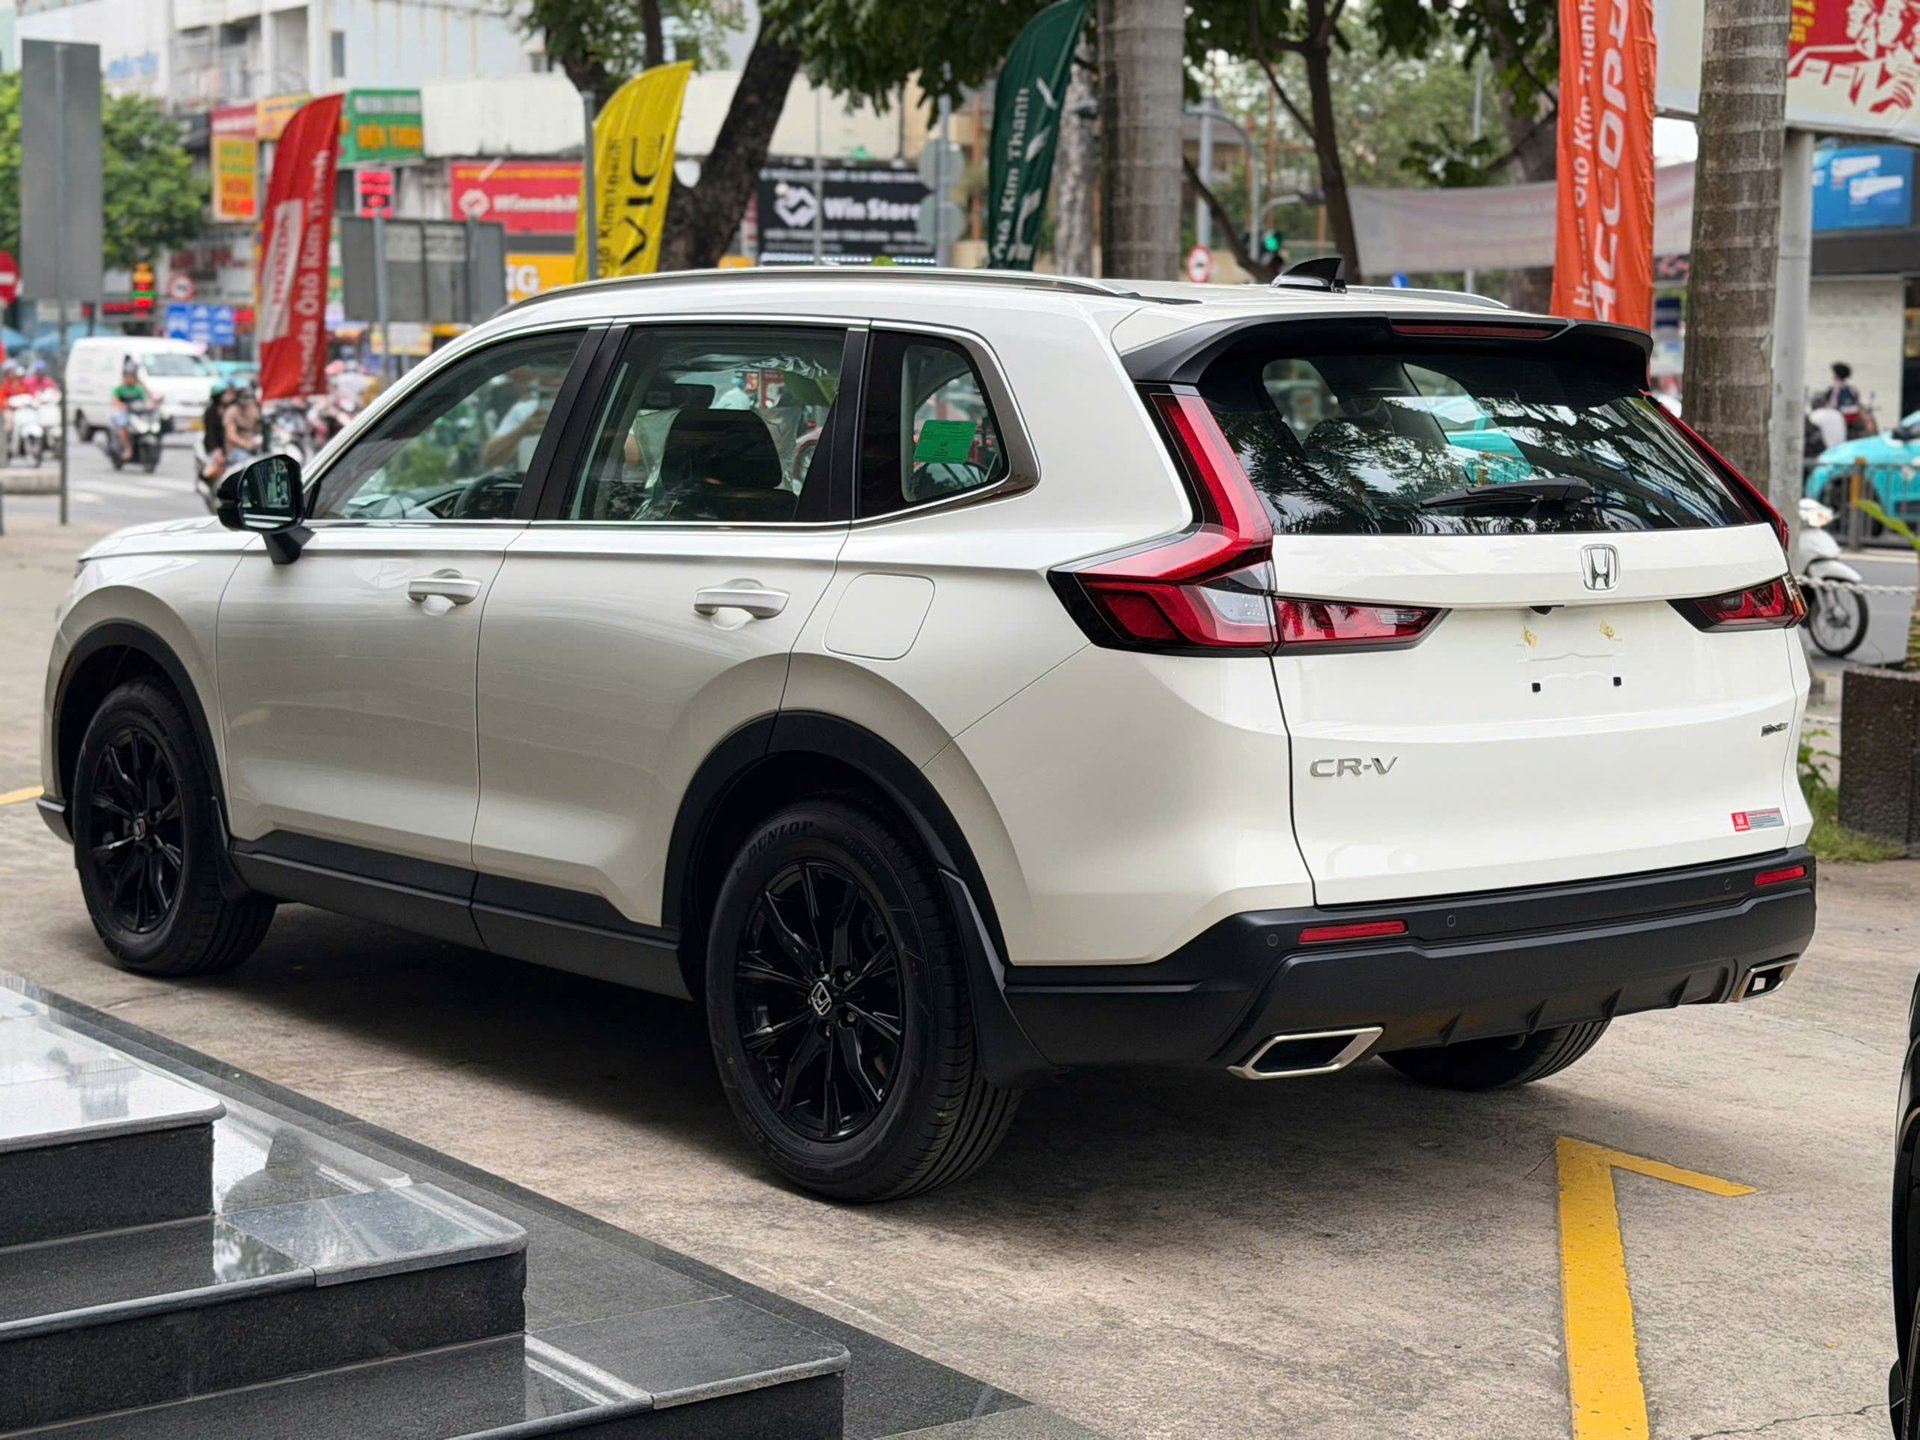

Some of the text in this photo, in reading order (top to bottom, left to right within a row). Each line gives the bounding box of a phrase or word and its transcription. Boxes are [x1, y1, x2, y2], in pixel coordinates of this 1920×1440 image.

[1573, 96, 1594, 151] Kim
[1309, 756, 1399, 778] CR-V
[747, 820, 814, 856] DUNLOP
